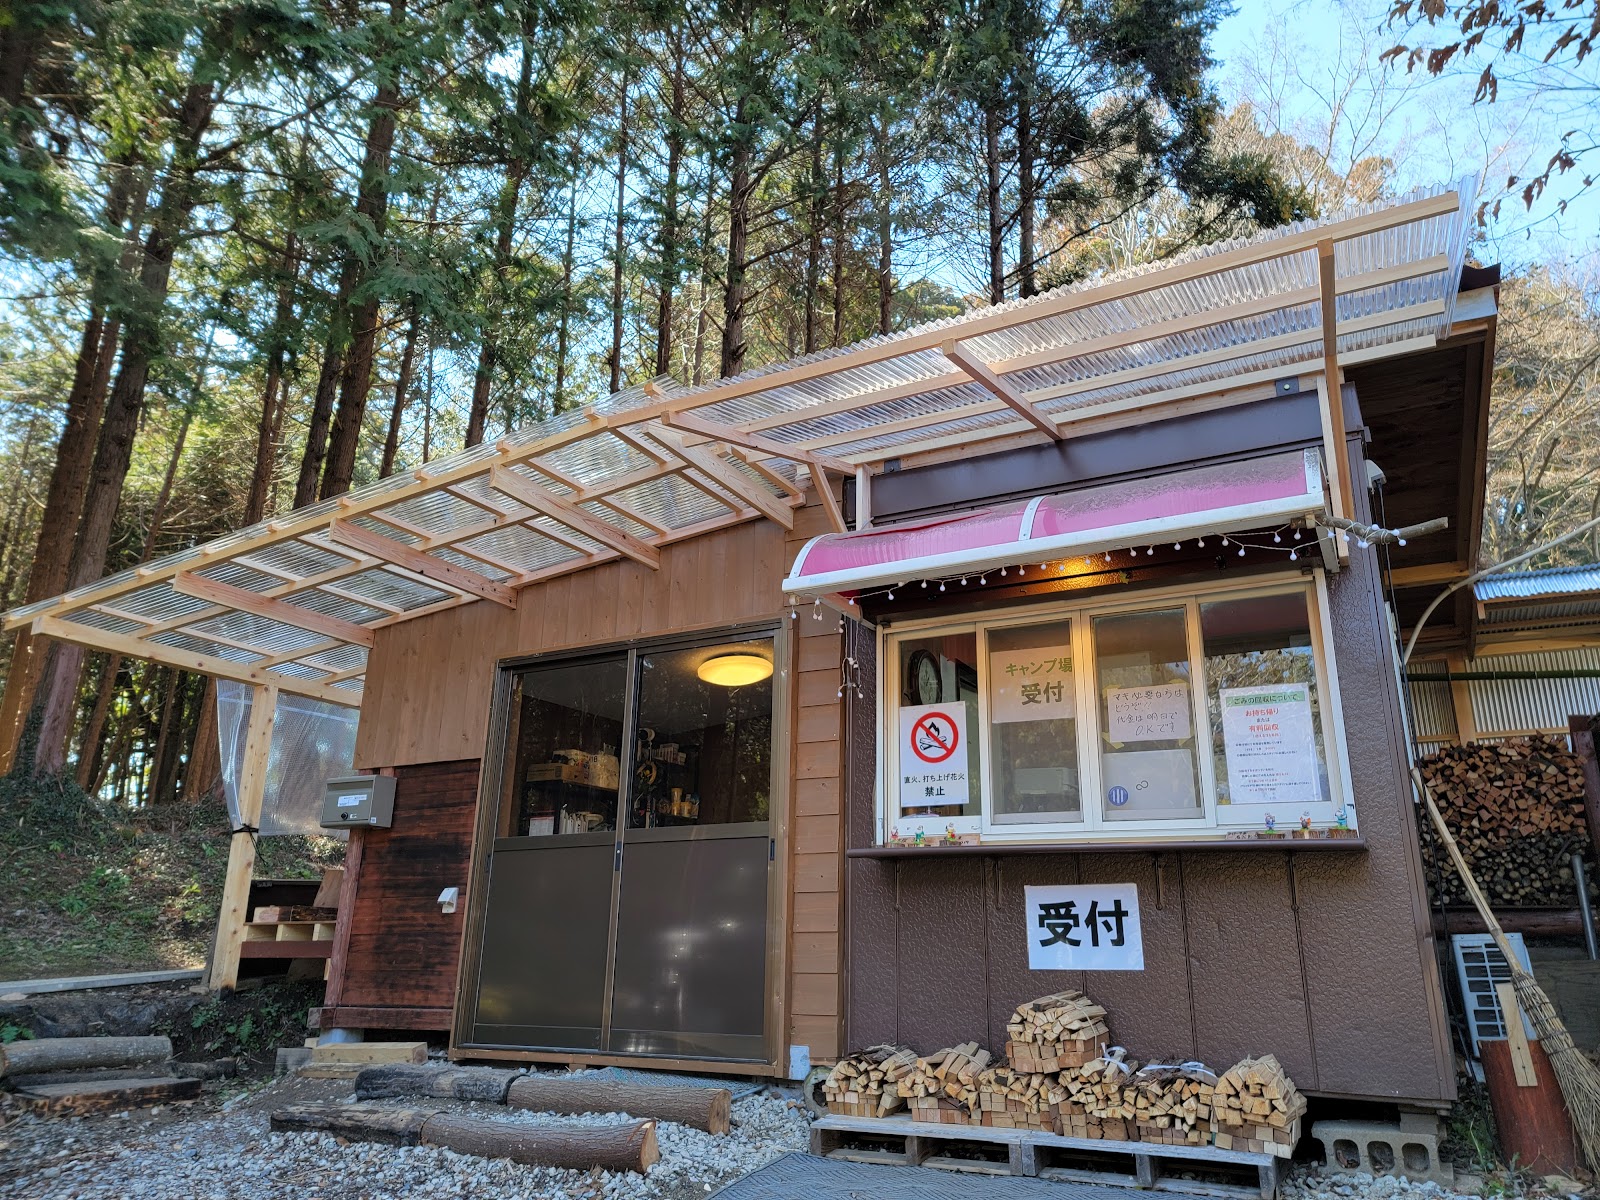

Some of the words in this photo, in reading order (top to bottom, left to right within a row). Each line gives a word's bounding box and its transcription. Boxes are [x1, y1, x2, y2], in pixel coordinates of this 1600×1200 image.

[1005, 657, 1073, 677] キャンプ場
[1021, 680, 1065, 706] 受付
[1234, 692, 1298, 705] ごみの回収について
[1245, 708, 1279, 717] お持ち帰り
[1248, 723, 1279, 733] 有料回収
[904, 773, 965, 784] 直火、打ち上げ花火
[924, 785, 946, 797] 禁止
[1037, 899, 1129, 948] 受付
